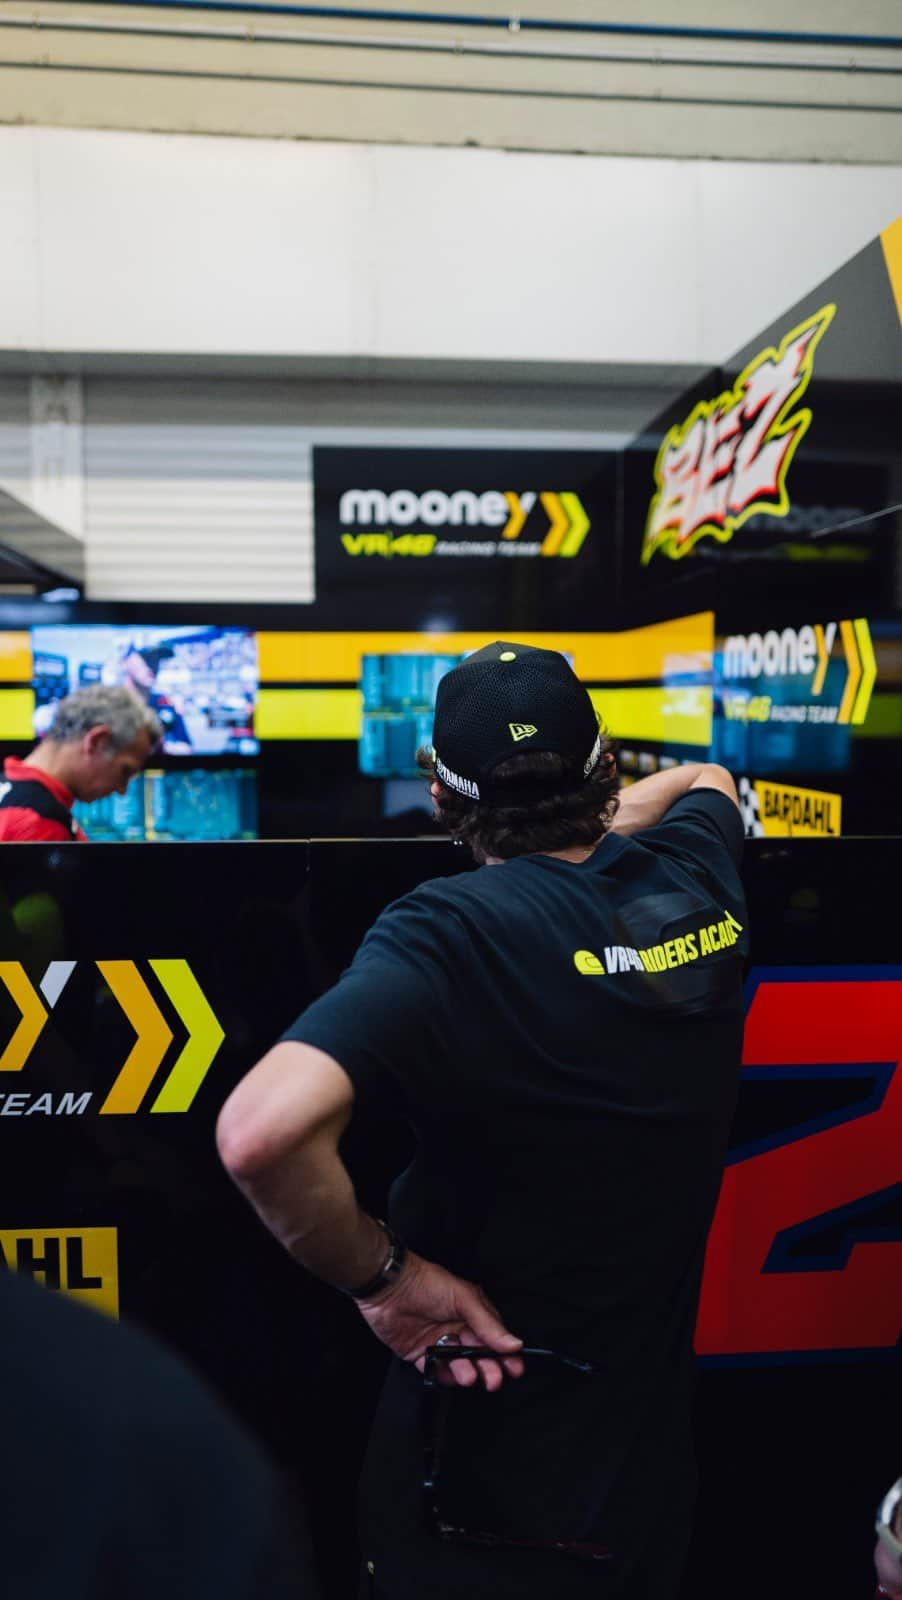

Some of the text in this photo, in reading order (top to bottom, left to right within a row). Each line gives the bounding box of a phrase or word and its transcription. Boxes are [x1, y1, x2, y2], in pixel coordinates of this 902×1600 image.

[646, 316, 825, 553] BEZ
[339, 489, 537, 539] mooney
[722, 622, 837, 696] mooney
[439, 763, 480, 798] YAMAHA
[764, 789, 835, 834] BARDAHL
[639, 933, 699, 972] RIDERS
[0, 1092, 93, 1116] EAM
